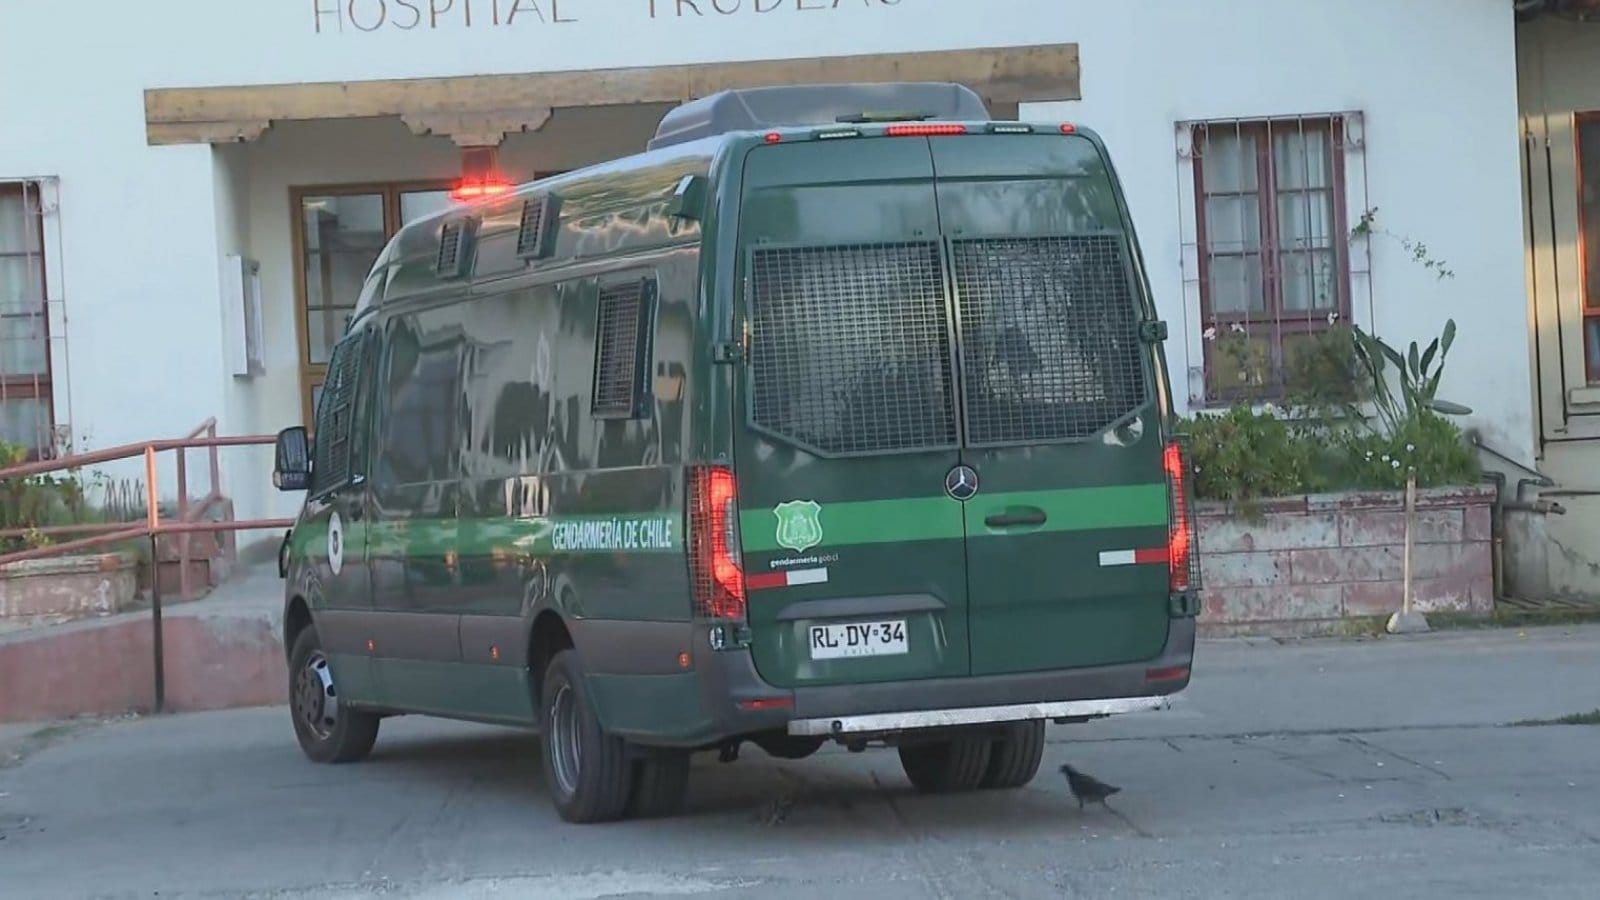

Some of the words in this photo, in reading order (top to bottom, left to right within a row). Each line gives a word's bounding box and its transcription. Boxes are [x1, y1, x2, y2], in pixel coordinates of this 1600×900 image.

[552, 517, 622, 550] GENDARMERÍA
[624, 520, 638, 549] DE
[640, 518, 673, 549] CHILE
